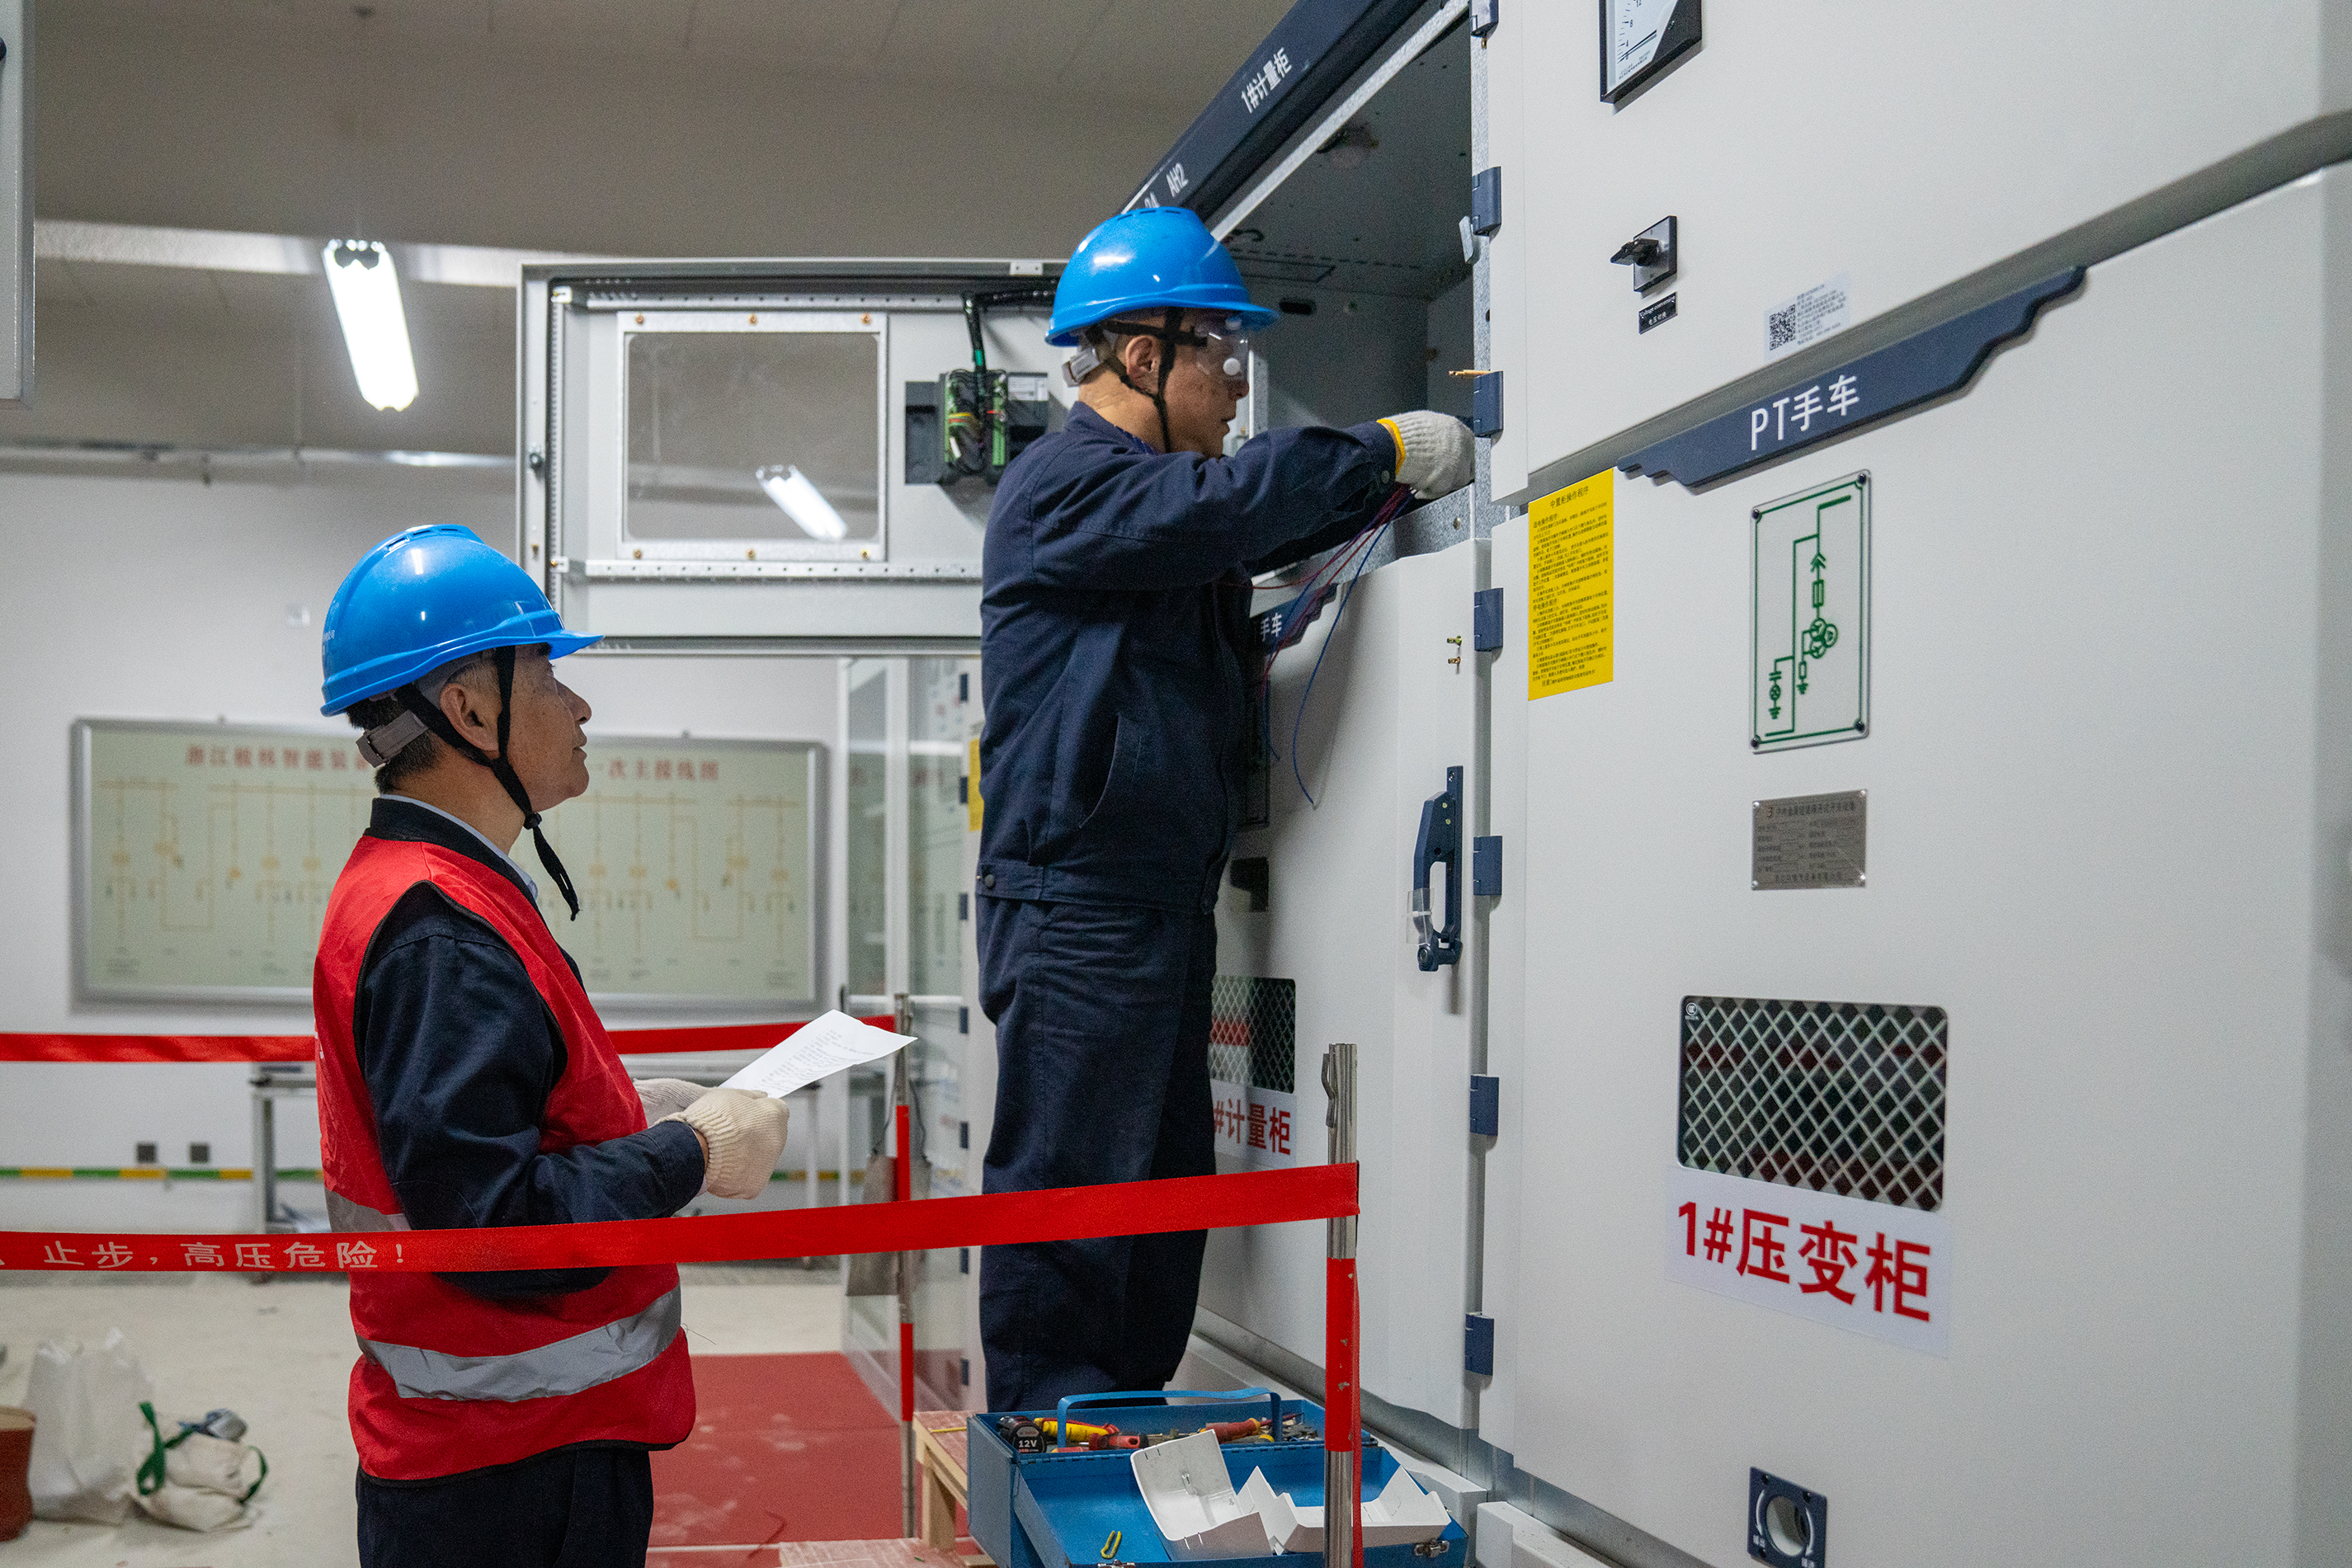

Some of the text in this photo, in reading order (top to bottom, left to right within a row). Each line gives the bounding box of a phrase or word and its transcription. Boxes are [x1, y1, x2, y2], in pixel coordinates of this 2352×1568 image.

[1629, 19, 1633, 28] 8
[1241, 47, 1293, 114] 1#计量柜
[1166, 162, 1189, 197] AH2
[1751, 374, 1860, 451] PT手车
[43, 1240, 404, 1269] 止步，高压危险！
[1677, 1201, 1931, 1323] 1#压变柜
[1018, 1439, 1037, 1448] 12V
